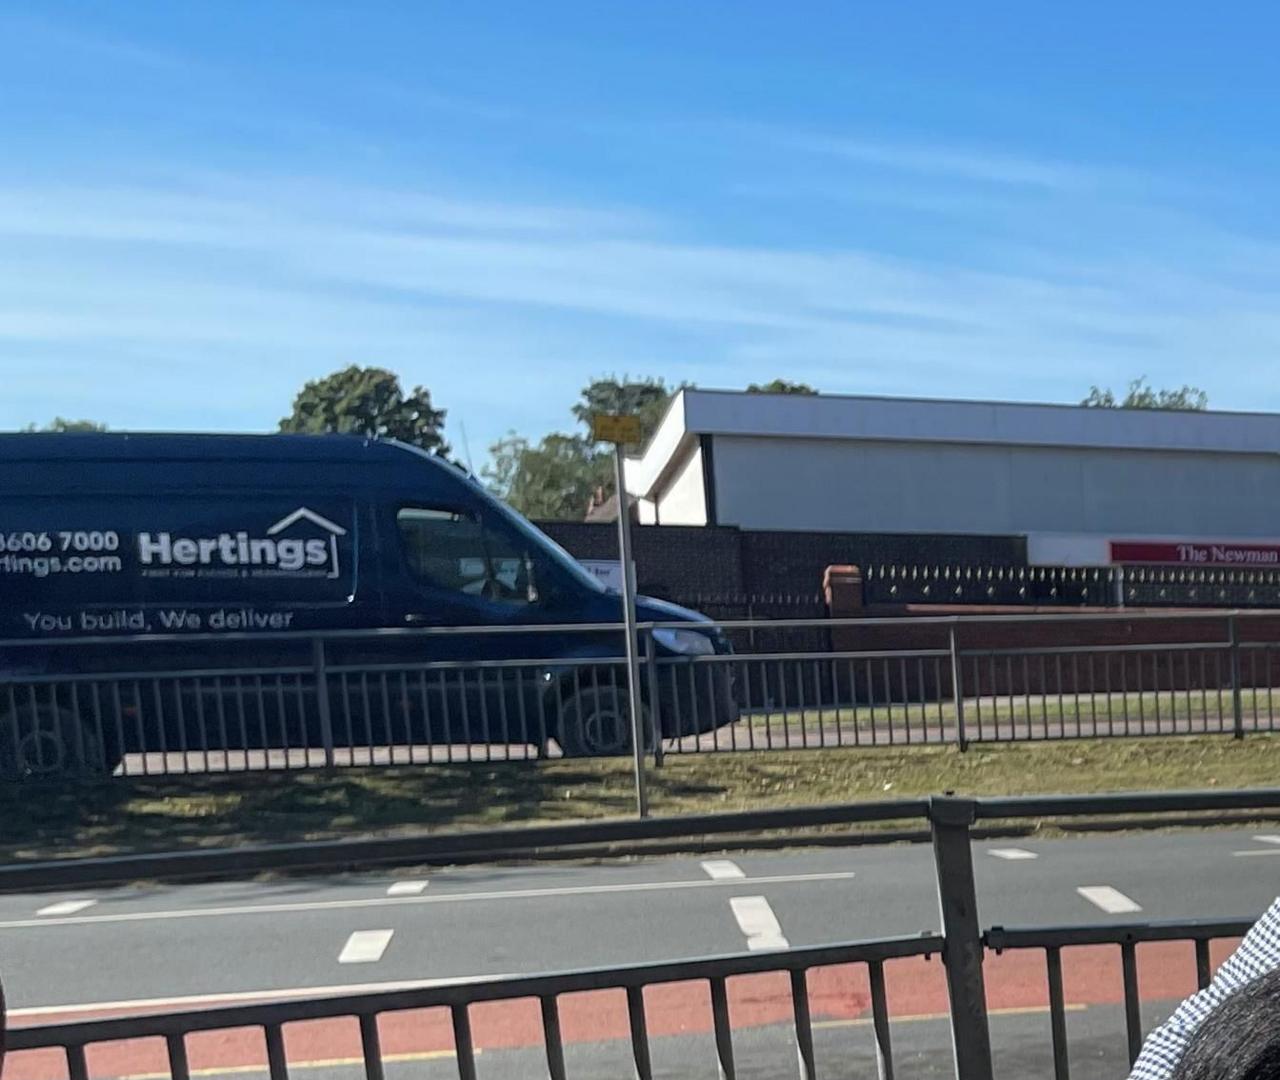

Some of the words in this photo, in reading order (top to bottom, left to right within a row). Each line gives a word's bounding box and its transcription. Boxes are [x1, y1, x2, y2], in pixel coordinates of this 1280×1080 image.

[58, 531, 119, 551] 7000
[139, 531, 328, 570] Hertings
[1177, 545, 1207, 561] The
[1211, 546, 1278, 562] Newman
[24, 611, 72, 630] You
[82, 609, 151, 631] build,
[160, 609, 200, 628] We
[208, 607, 293, 628] deliver
